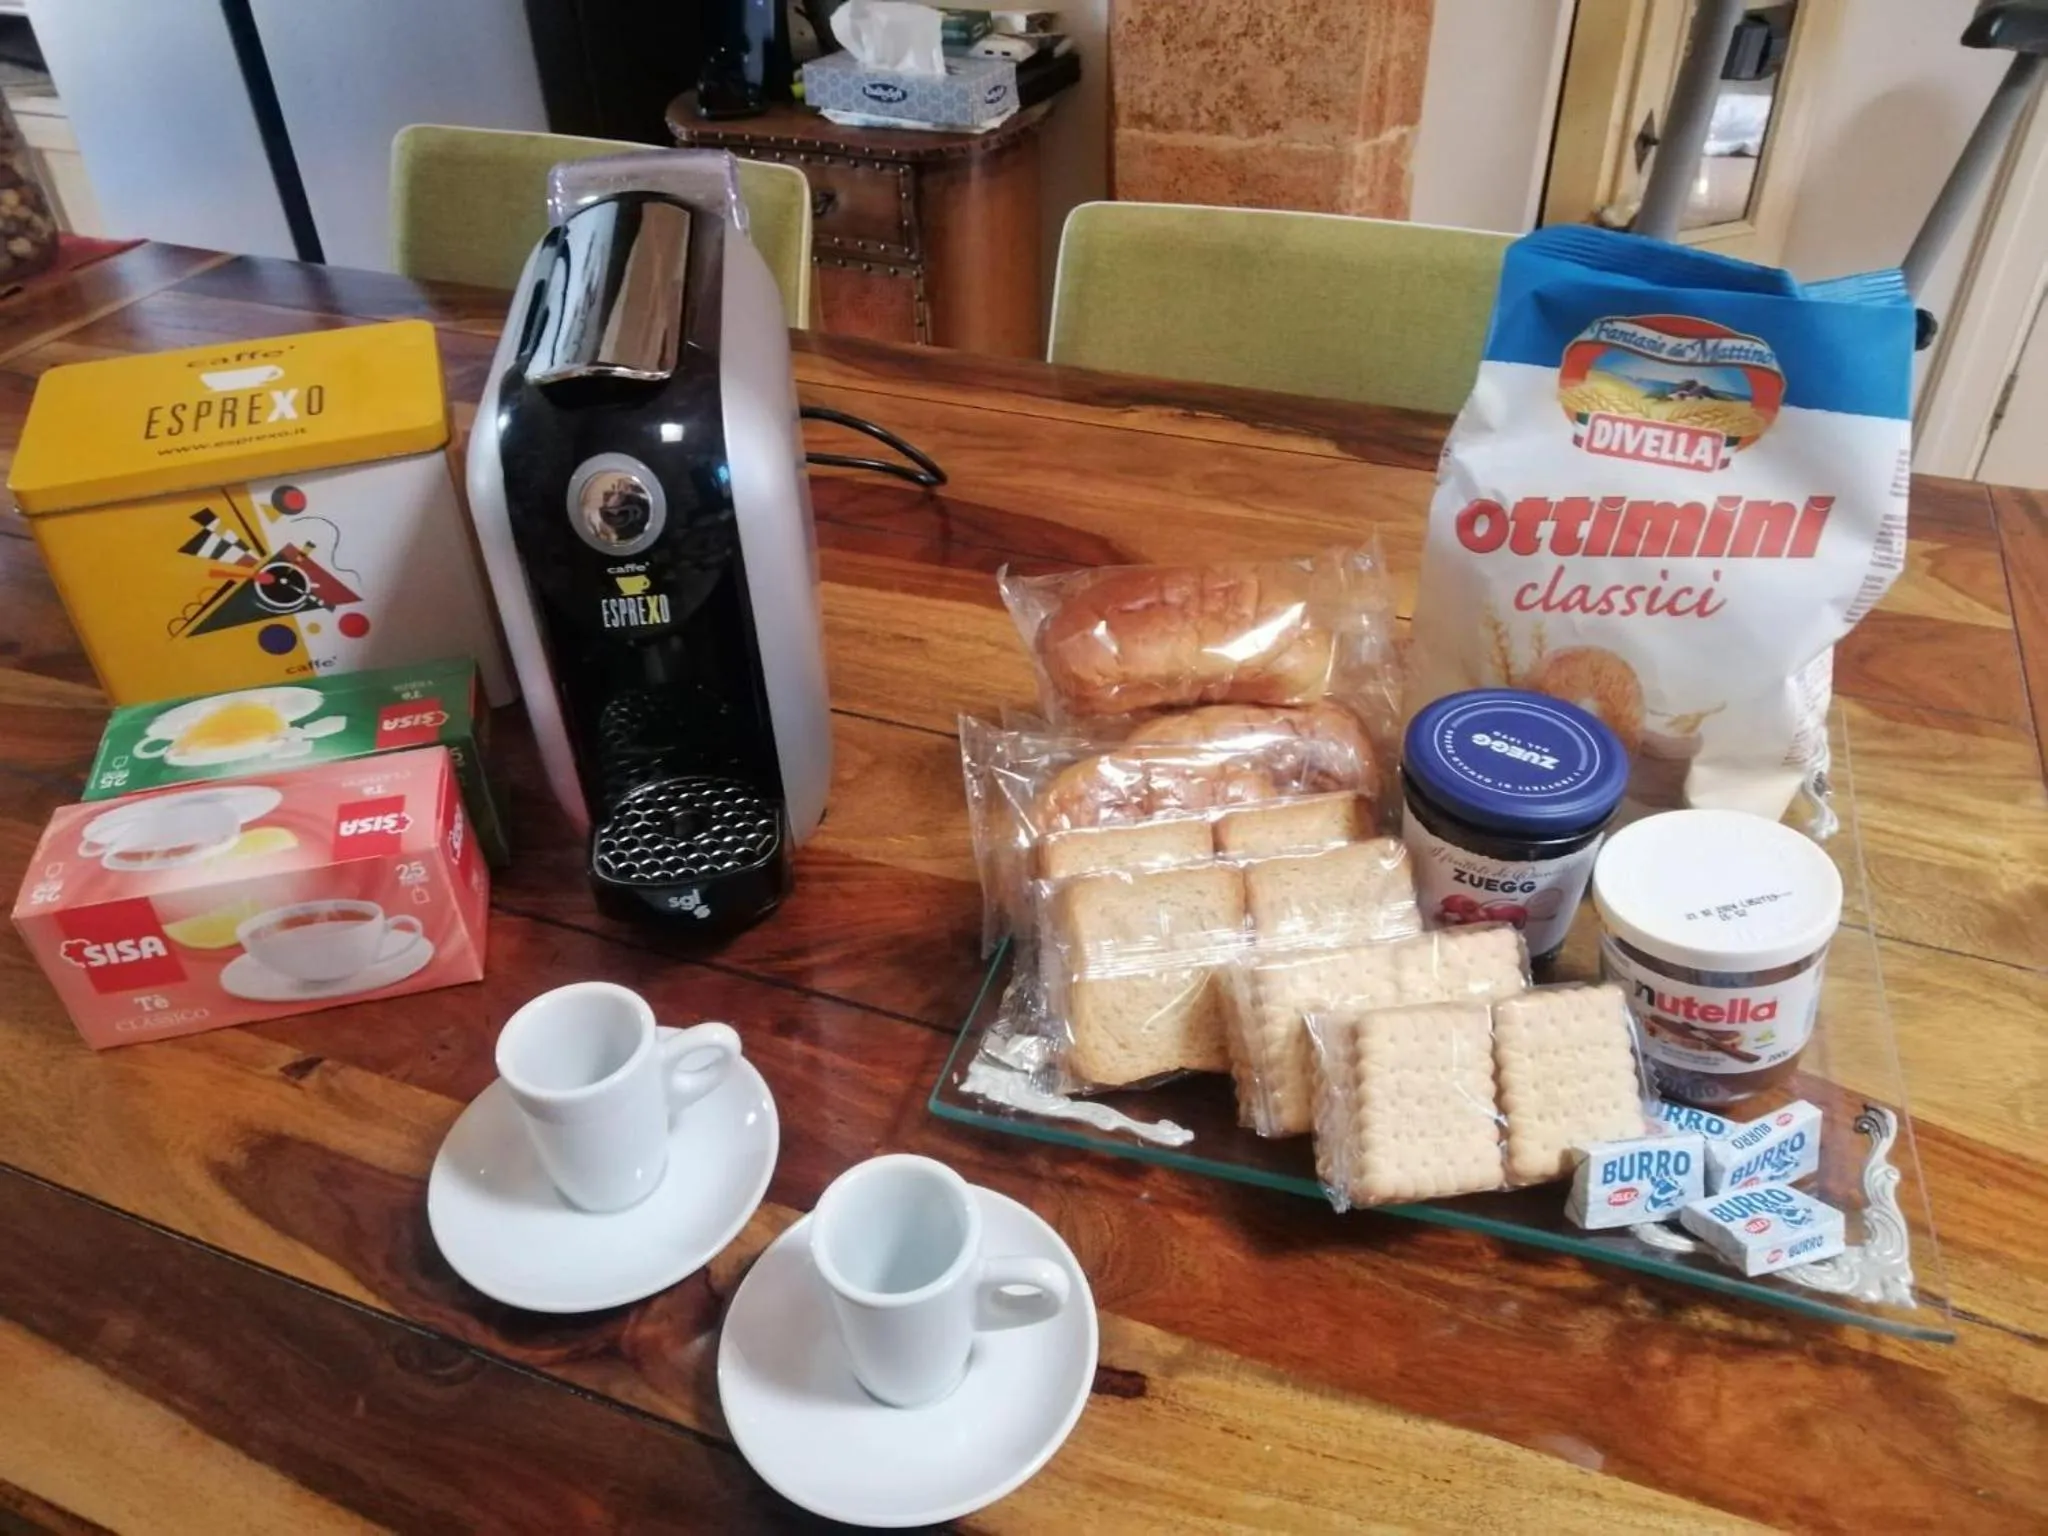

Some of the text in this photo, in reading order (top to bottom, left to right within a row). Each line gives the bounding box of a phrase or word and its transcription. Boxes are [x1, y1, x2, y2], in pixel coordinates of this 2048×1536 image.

[144, 384, 325, 440] ESPREXO
[1591, 420, 1716, 468] DIVELLA
[1455, 494, 1837, 559] ottimini
[1513, 563, 1729, 619] classici
[601, 594, 671, 628] ESPREXO
[382, 711, 437, 731] SISA
[1471, 732, 1561, 771] ZUEGG
[338, 812, 400, 838] SISA
[1452, 868, 1537, 893] ZUEGG
[83, 936, 168, 967] SISA
[1634, 979, 1778, 1024] nutella
[1602, 1150, 1692, 1185] BURRO
[1730, 1132, 1806, 1187] BURRO
[1709, 1188, 1795, 1224] BURRO
[1788, 1235, 1825, 1258] BURRO
